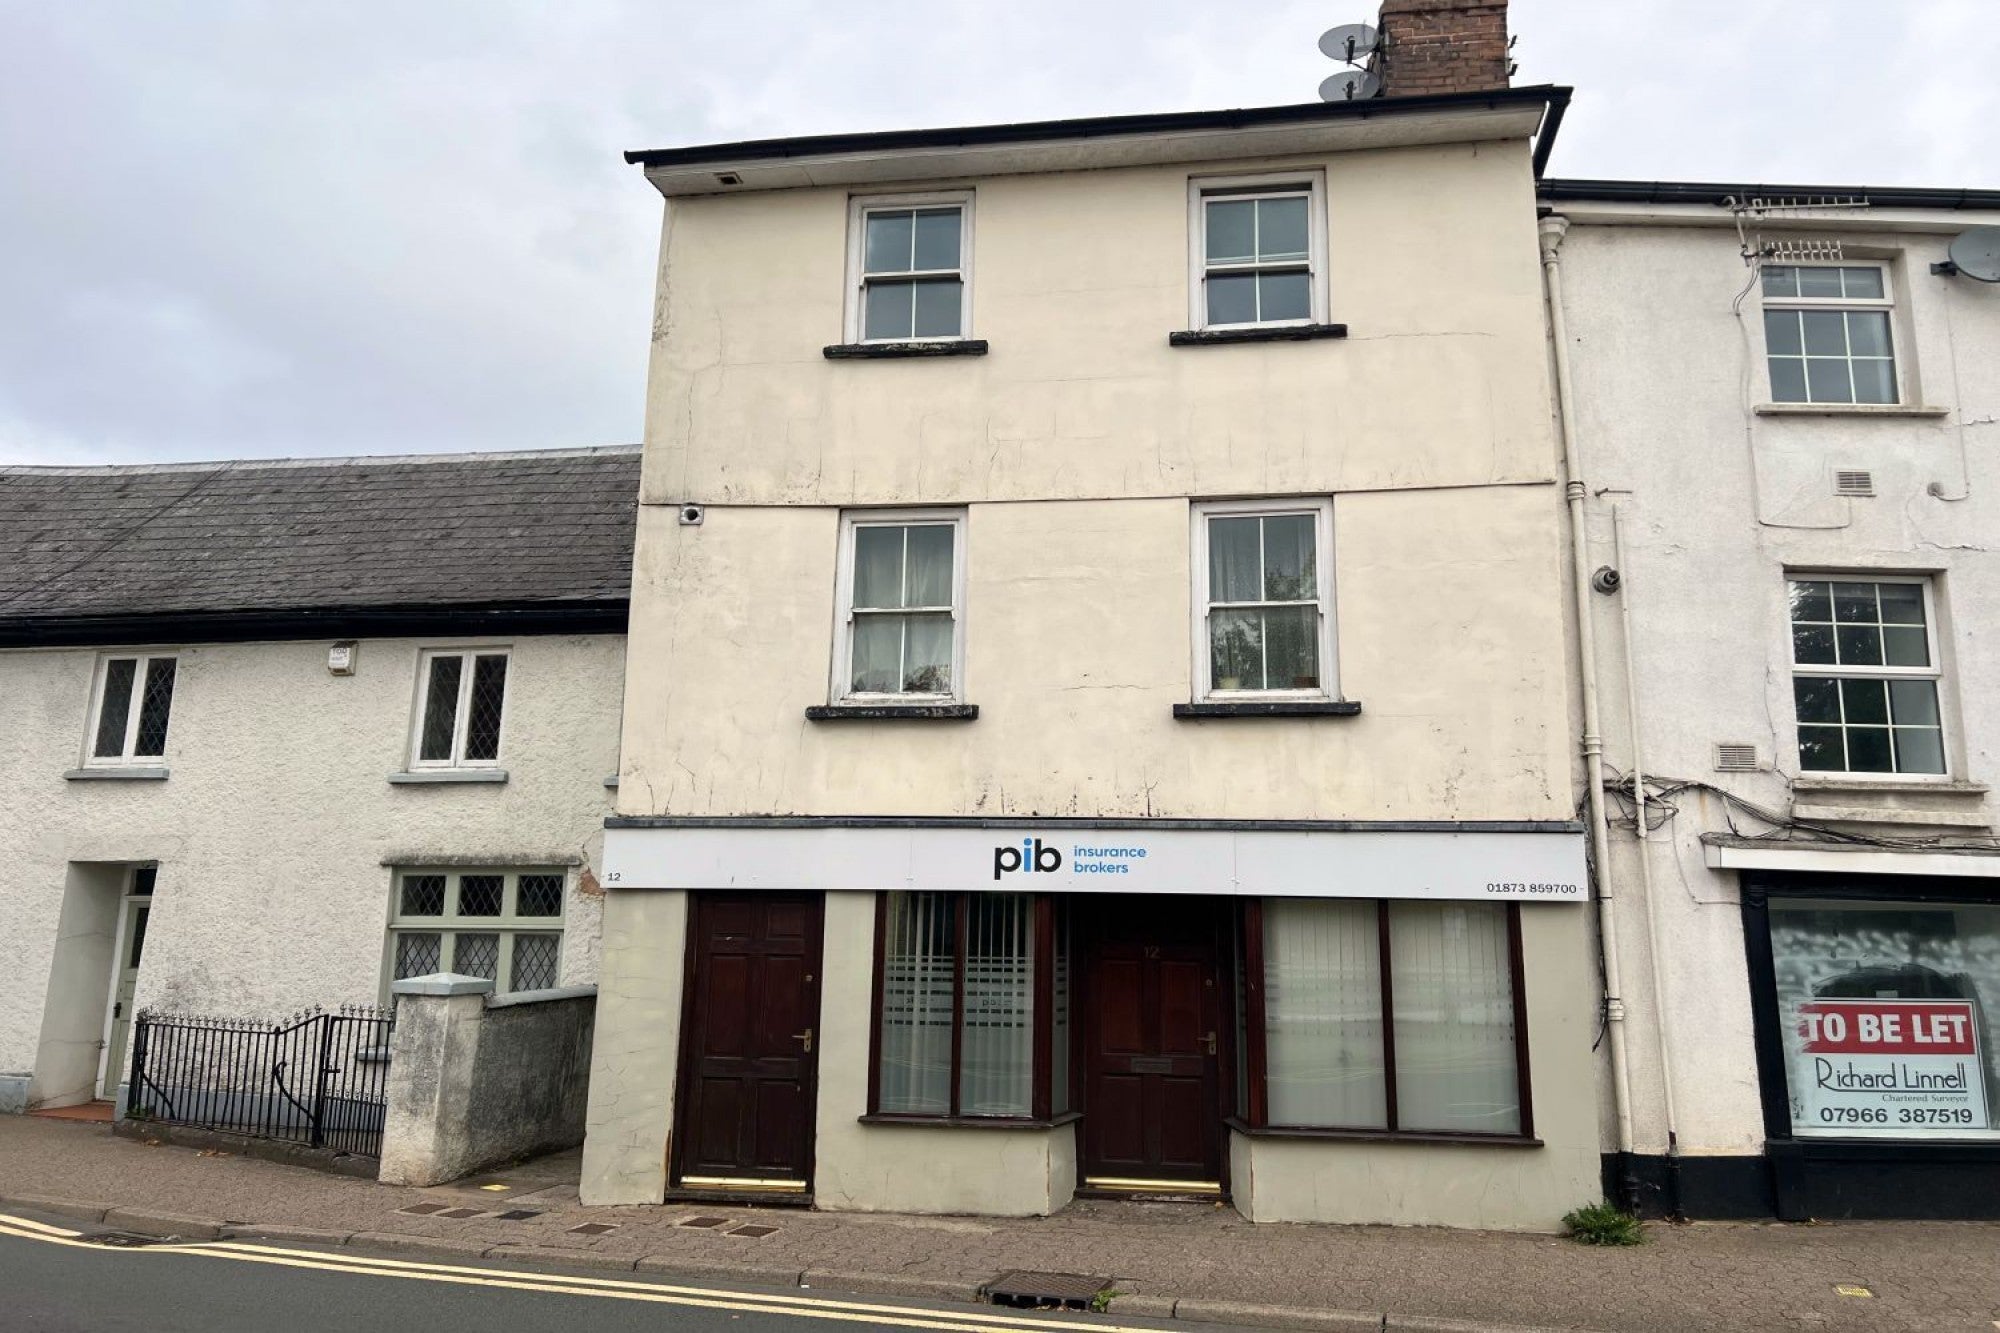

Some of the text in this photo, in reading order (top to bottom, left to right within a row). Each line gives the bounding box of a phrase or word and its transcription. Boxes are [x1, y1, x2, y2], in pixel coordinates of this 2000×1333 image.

[1074, 845, 1147, 858] insurance
[994, 838, 1062, 880] pib
[1074, 861, 1129, 874] brokers
[608, 872, 621, 882] 12
[1487, 883, 1577, 894] 01873 859700
[1144, 945, 1161, 959] 12
[1805, 1012, 1968, 1044] TO BE LET
[1815, 1057, 1967, 1090] Richard Linnell
[1882, 1094, 1928, 1103] Chartered
[1820, 1107, 1973, 1124] 07966 387519
